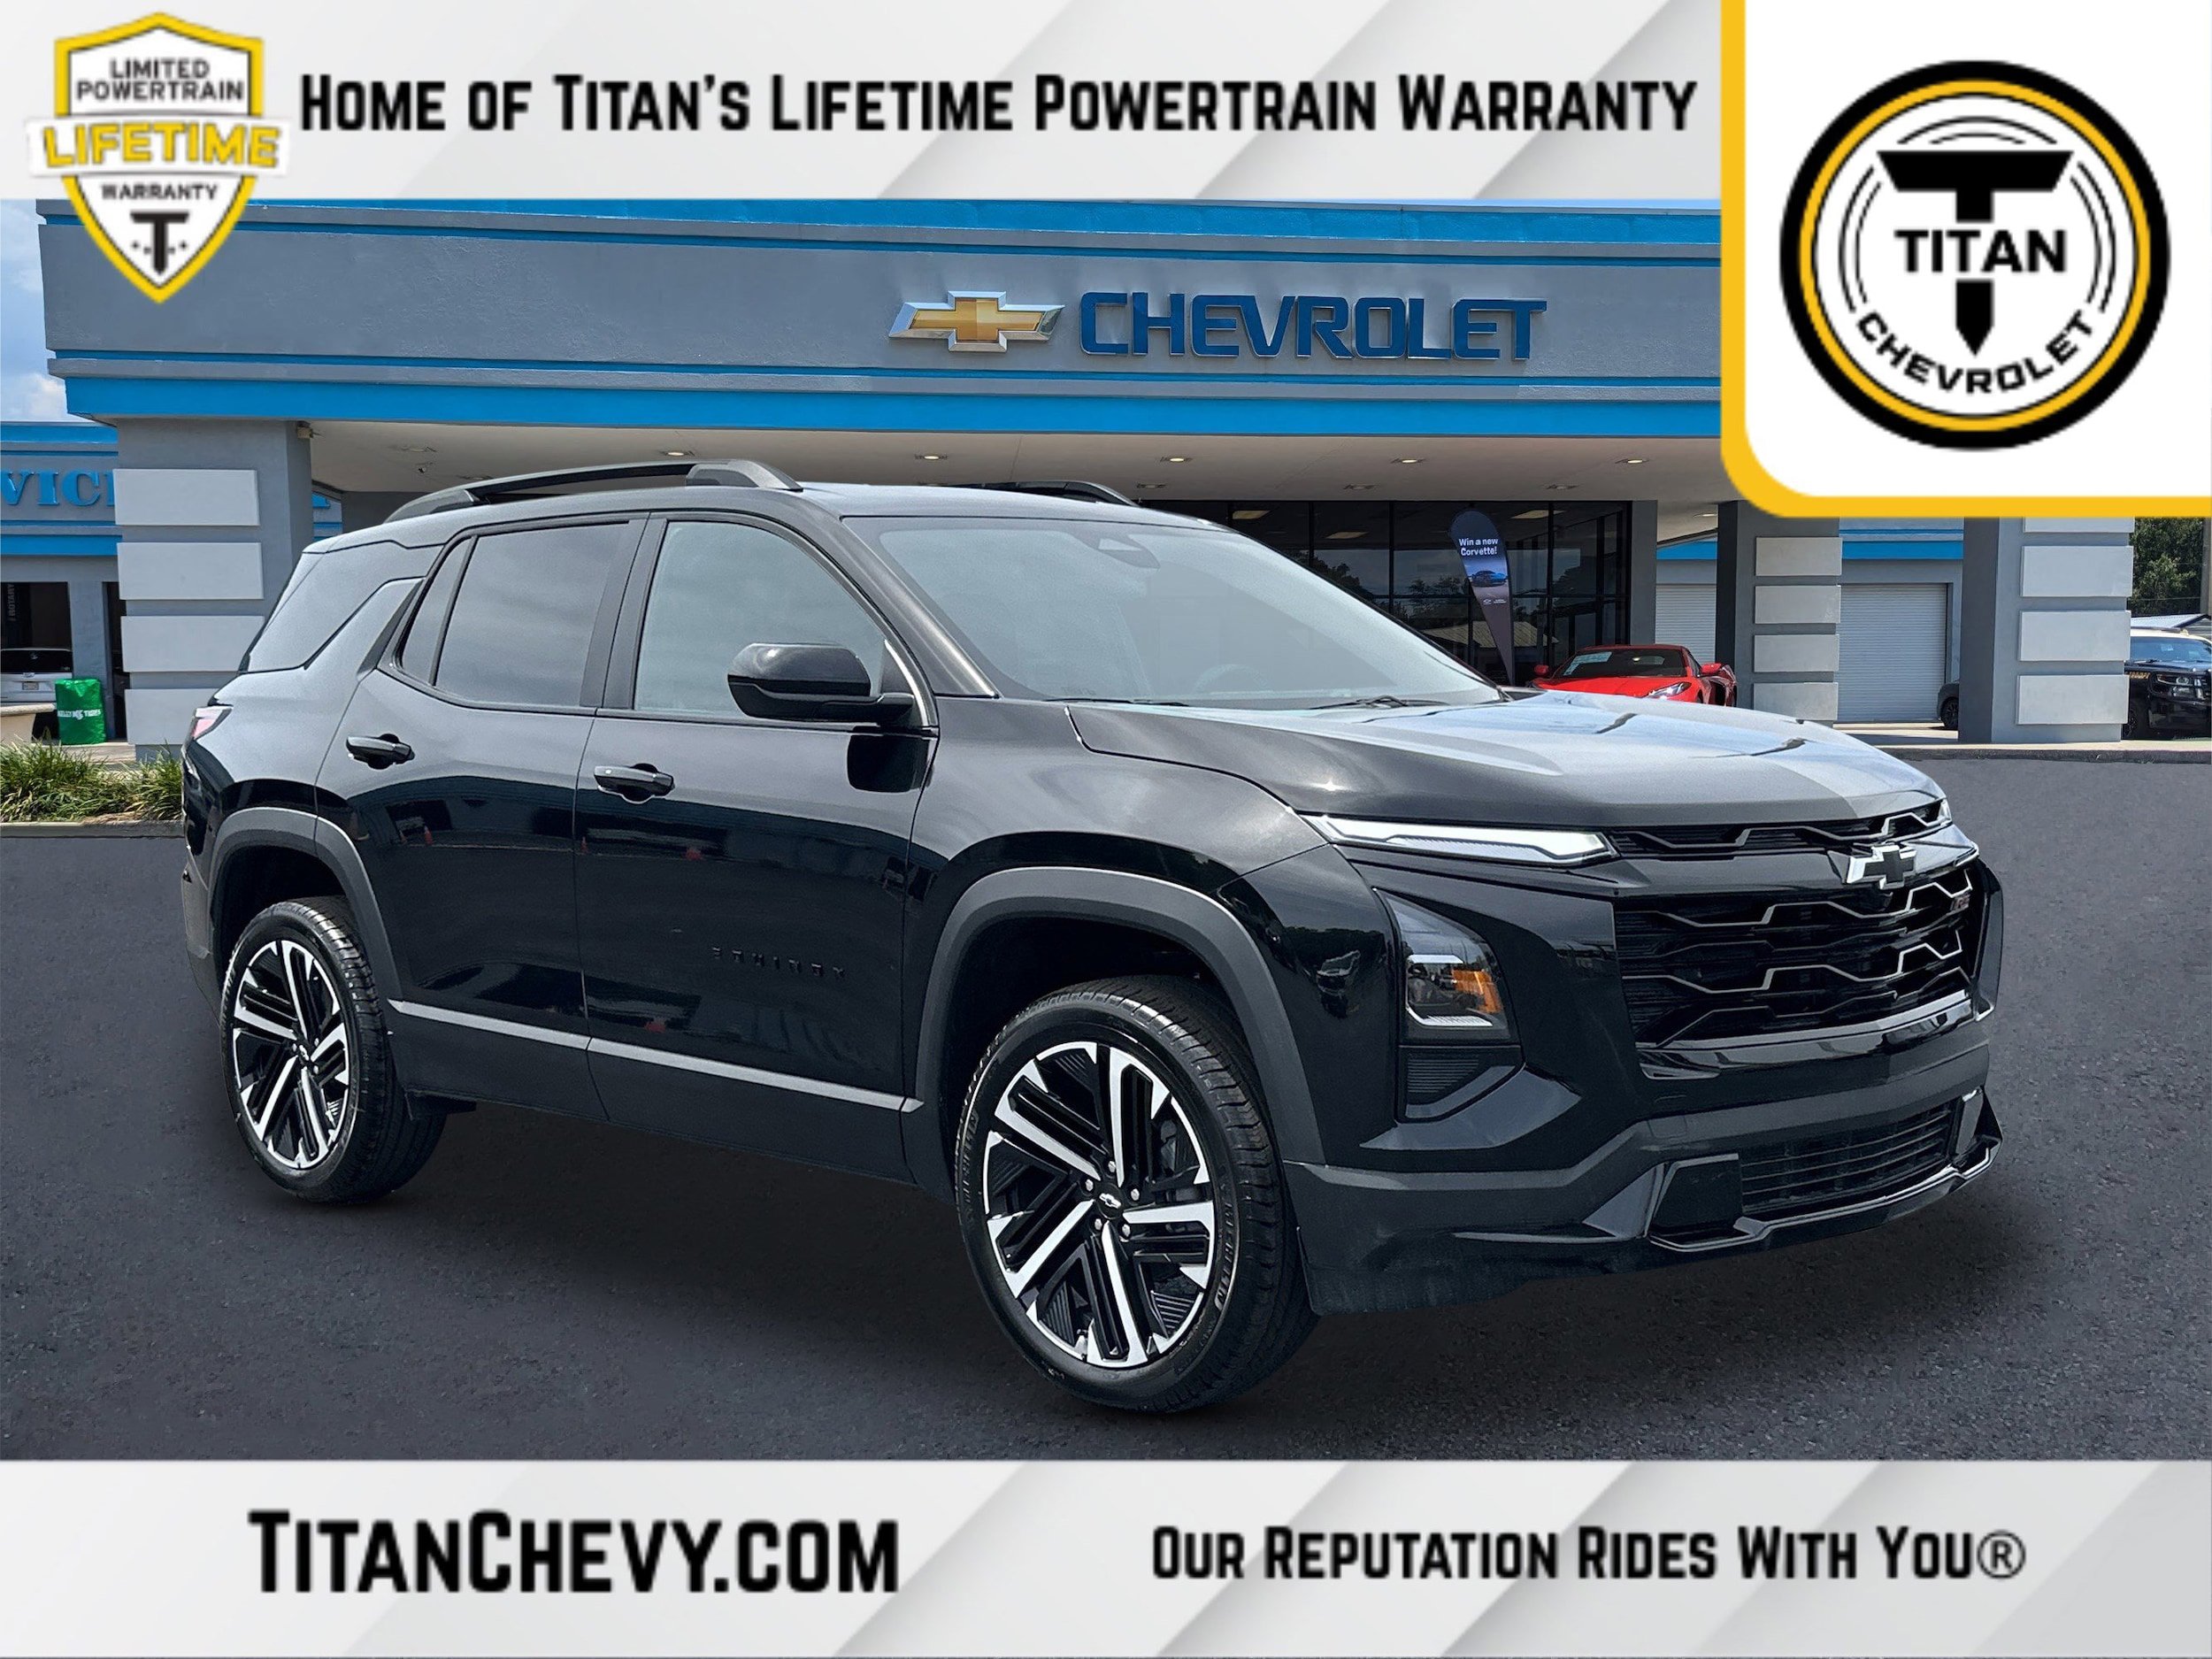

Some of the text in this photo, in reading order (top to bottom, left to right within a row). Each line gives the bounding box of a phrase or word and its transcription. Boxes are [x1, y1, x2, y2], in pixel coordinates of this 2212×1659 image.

[1080, 291, 1548, 361] CHEVROLET
[1458, 537, 1474, 547] Win
[1460, 546, 1498, 556] Corvette!
